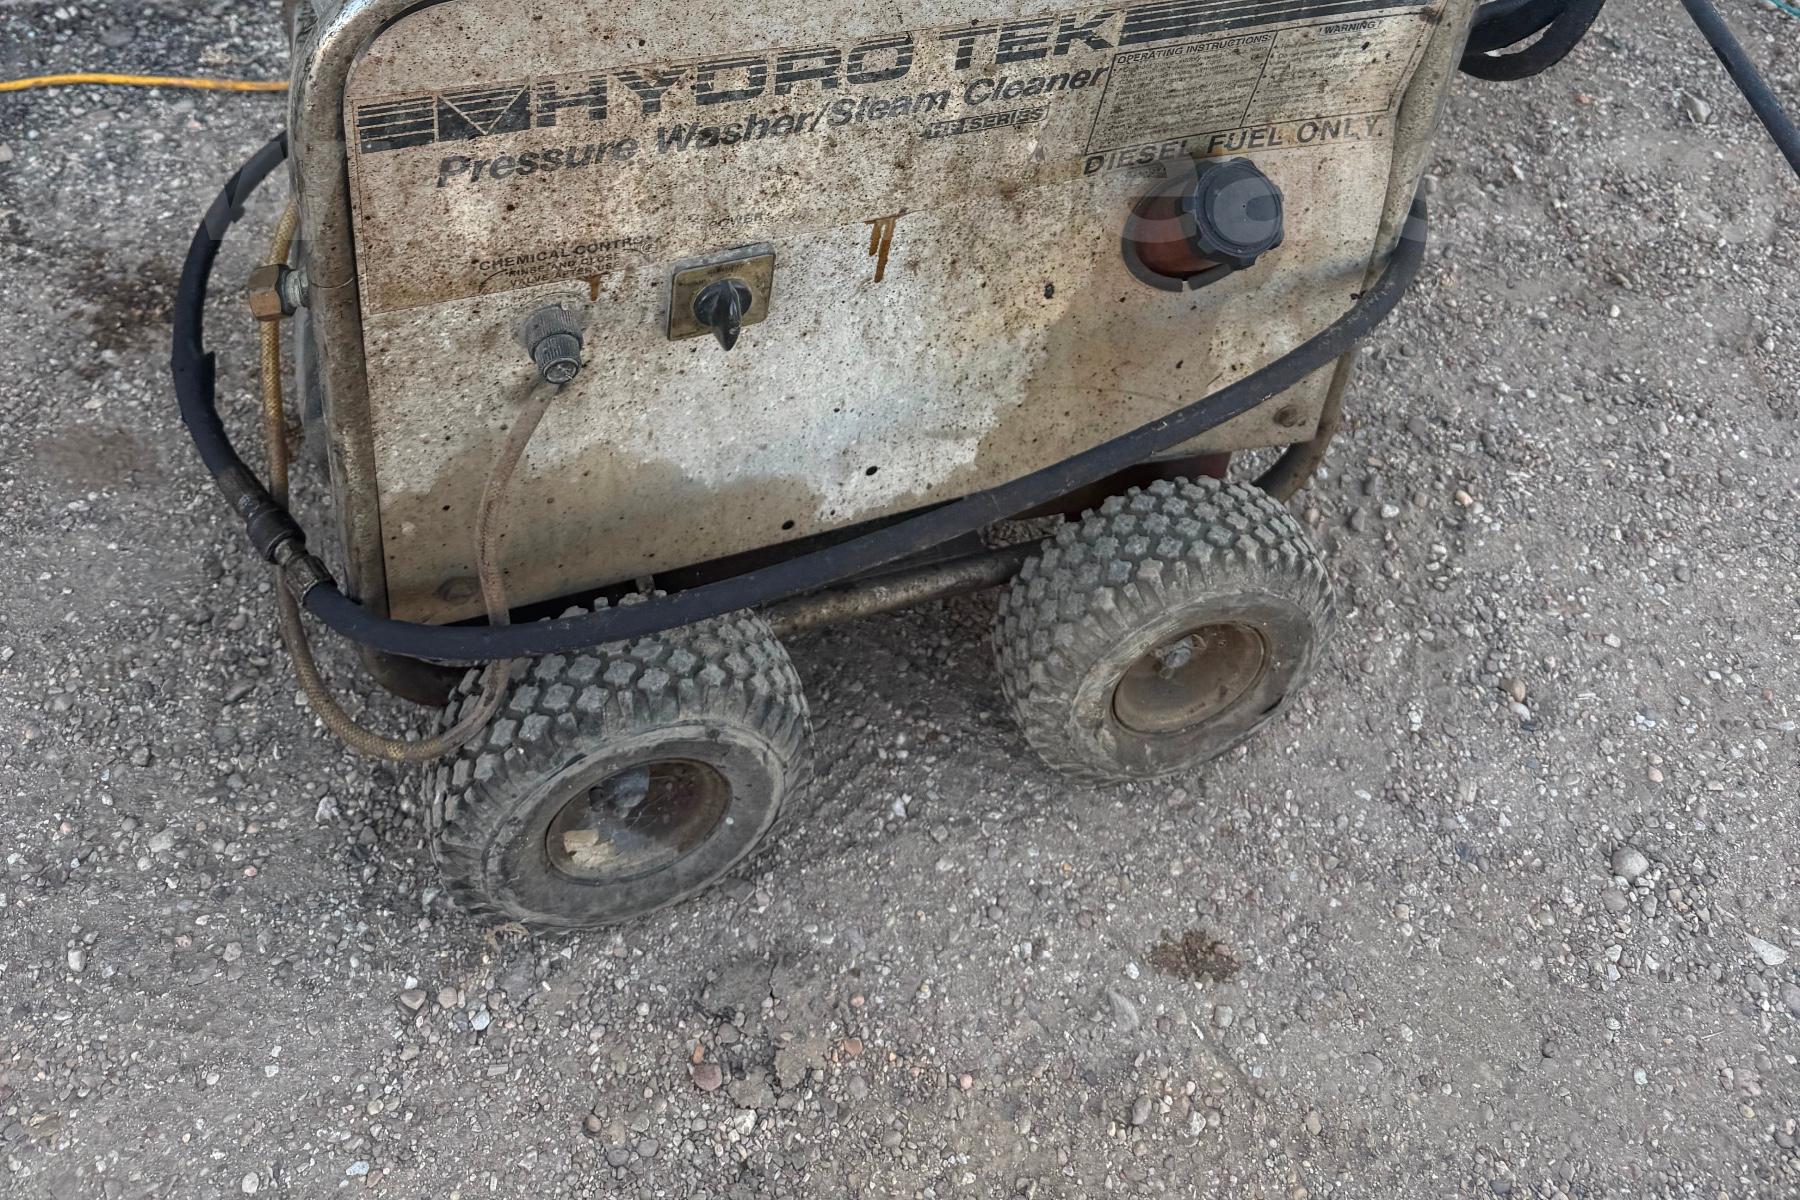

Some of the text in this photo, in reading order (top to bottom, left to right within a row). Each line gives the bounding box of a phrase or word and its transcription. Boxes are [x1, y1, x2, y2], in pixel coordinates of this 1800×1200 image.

[1324, 20, 1376, 35] WARNING
[1117, 46, 1184, 65] OPERATING
[536, 9, 1116, 127] HYDRO TEK
[437, 138, 639, 188] Pressure
[657, 88, 950, 155] Washer/Steam
[964, 66, 1109, 106] Cleaner
[970, 107, 1044, 130] SERIES
[1084, 138, 1194, 175] DIESEL
[1207, 125, 1283, 154] FUEL
[479, 248, 570, 271] CHEMICAL
[508, 252, 620, 278] RINSE AND CLOSE
[510, 274, 549, 287] VALVE
